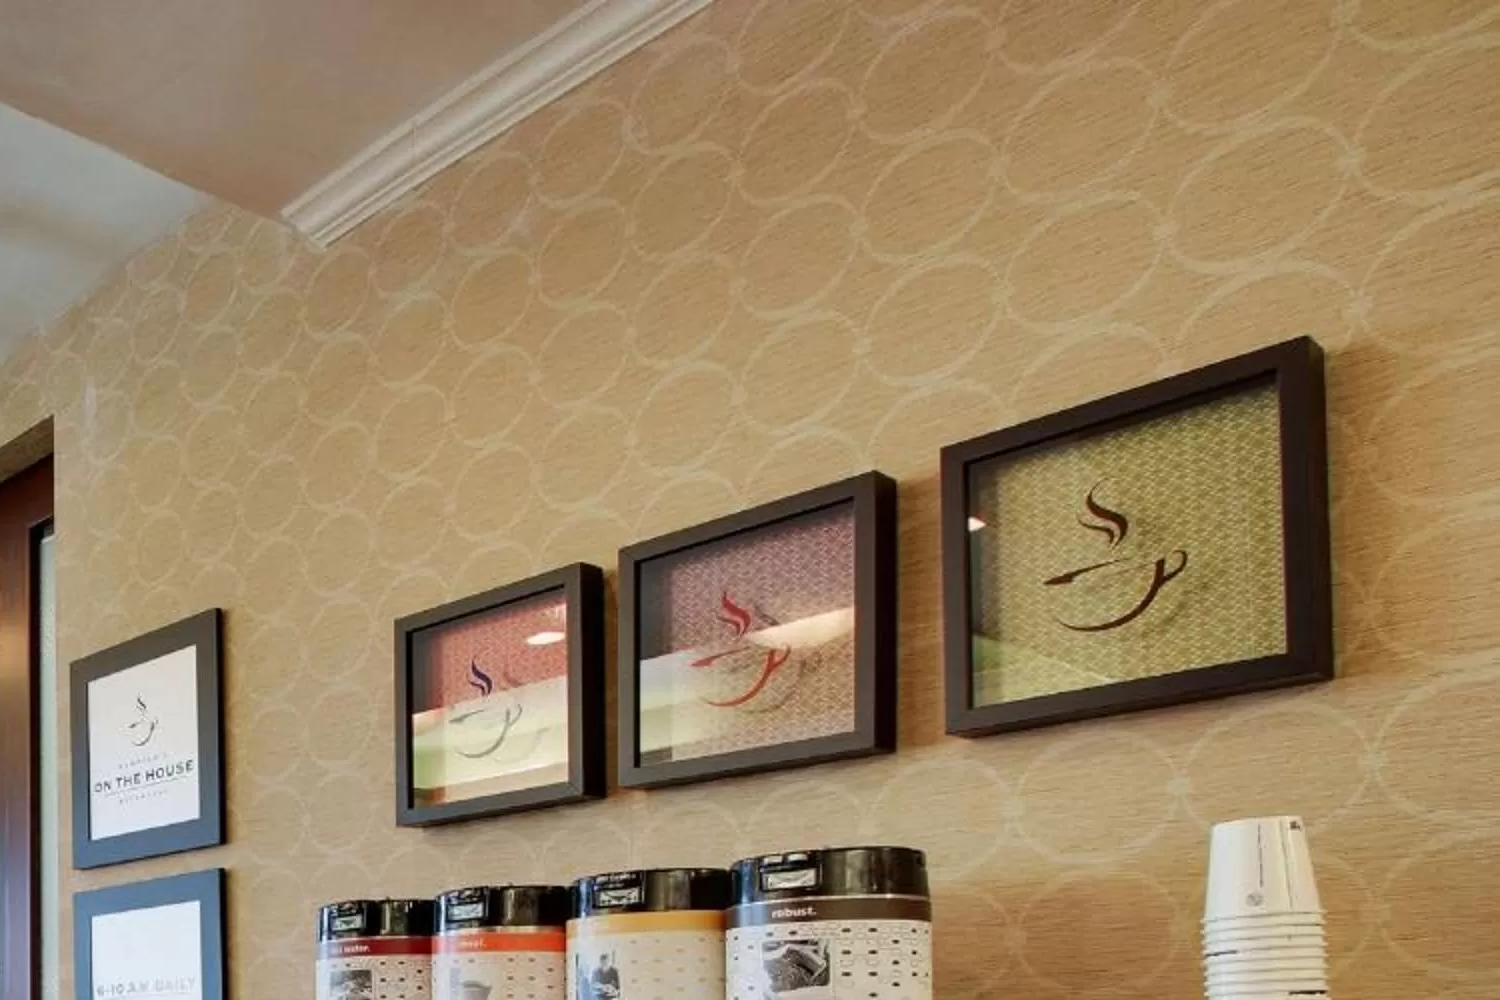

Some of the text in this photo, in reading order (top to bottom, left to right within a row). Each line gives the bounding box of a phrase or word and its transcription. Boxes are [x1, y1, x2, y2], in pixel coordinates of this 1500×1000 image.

[94, 781, 111, 793] ON
[116, 772, 141, 788] THE
[145, 759, 195, 781] HOUSE
[771, 907, 817, 919] robust.
